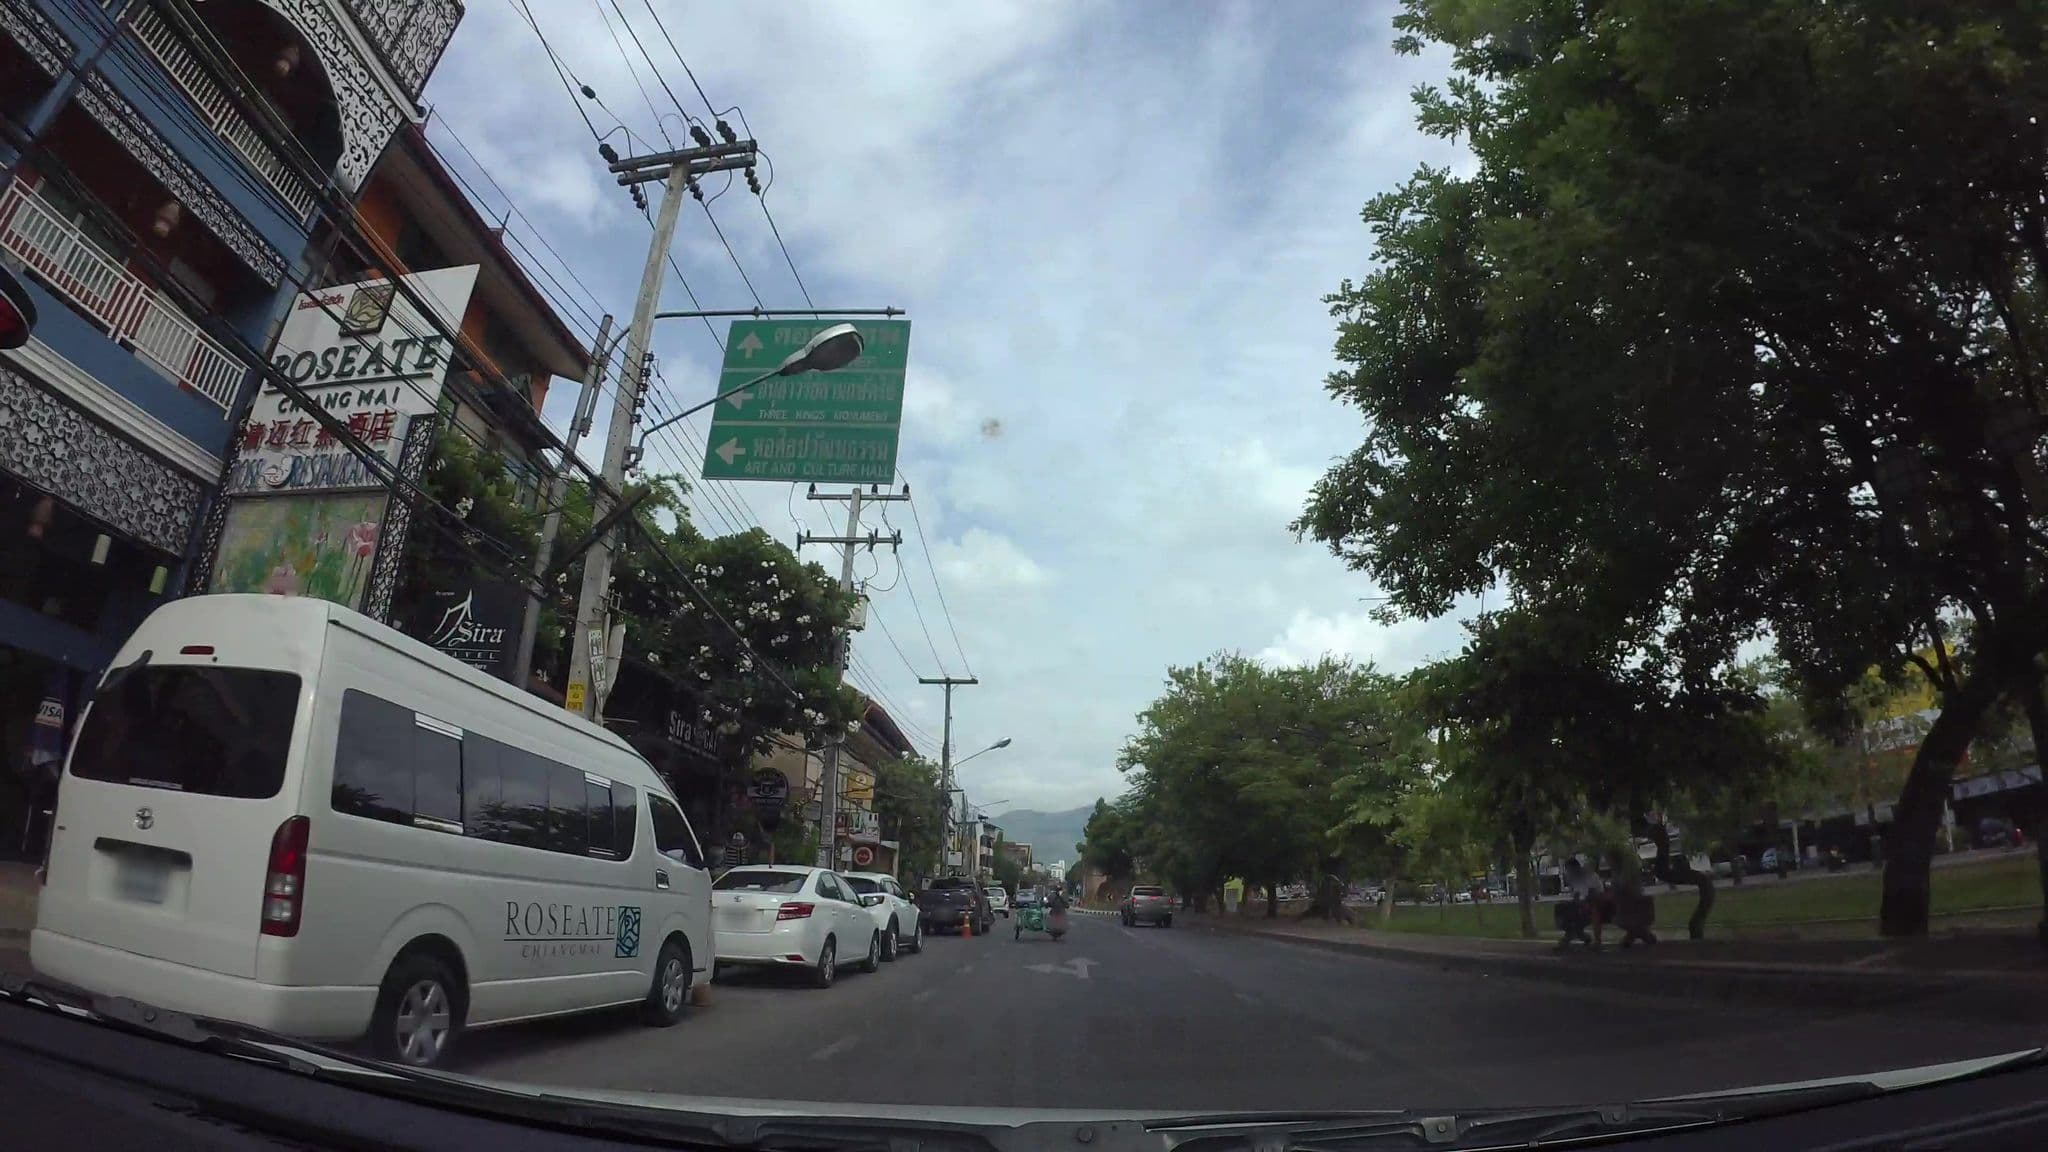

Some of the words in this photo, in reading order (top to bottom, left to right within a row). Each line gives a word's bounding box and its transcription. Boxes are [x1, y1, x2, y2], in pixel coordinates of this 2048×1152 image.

[267, 334, 443, 387] ROSEATE
[278, 391, 352, 413] CHANG
[358, 386, 400, 406] MAI
[759, 410, 788, 420] THREE
[795, 410, 825, 420] KINGS
[833, 411, 889, 421] MONUMENT
[744, 461, 767, 474] ART
[771, 462, 795, 474] AND
[803, 463, 858, 476] CULTURE
[861, 464, 890, 477] HALL
[39, 704, 63, 719] VISA
[669, 710, 692, 742] Sira
[505, 901, 616, 935] ROSEATE
